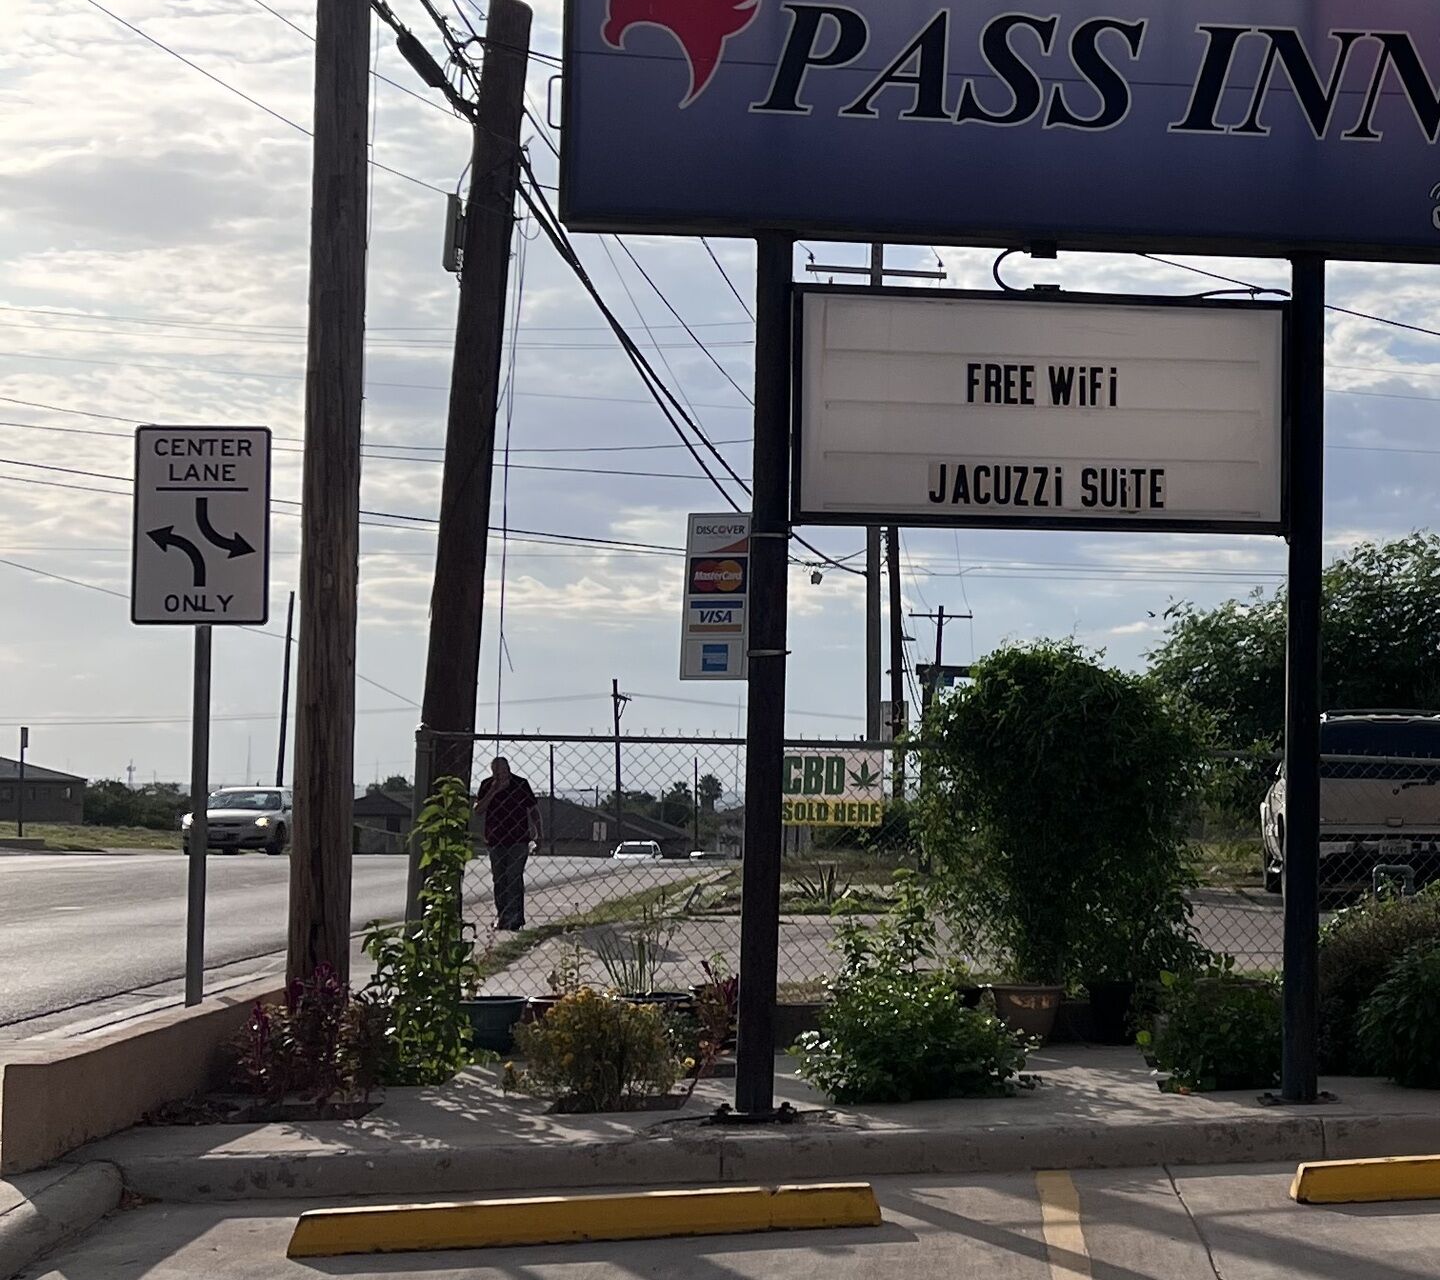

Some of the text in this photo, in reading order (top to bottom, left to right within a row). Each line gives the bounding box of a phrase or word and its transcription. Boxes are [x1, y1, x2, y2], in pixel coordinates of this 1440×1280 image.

[750, 2, 1146, 132] PASS
[966, 362, 1036, 406] FREE
[153, 438, 253, 457] CENTER
[168, 463, 237, 482] LANE
[695, 524, 746, 536] DISCOVER
[693, 570, 744, 582] MasterCard
[164, 593, 234, 613] ONLY
[699, 610, 733, 624] VISA
[783, 755, 846, 795] CBD
[782, 802, 880, 823] SOLD HERE
